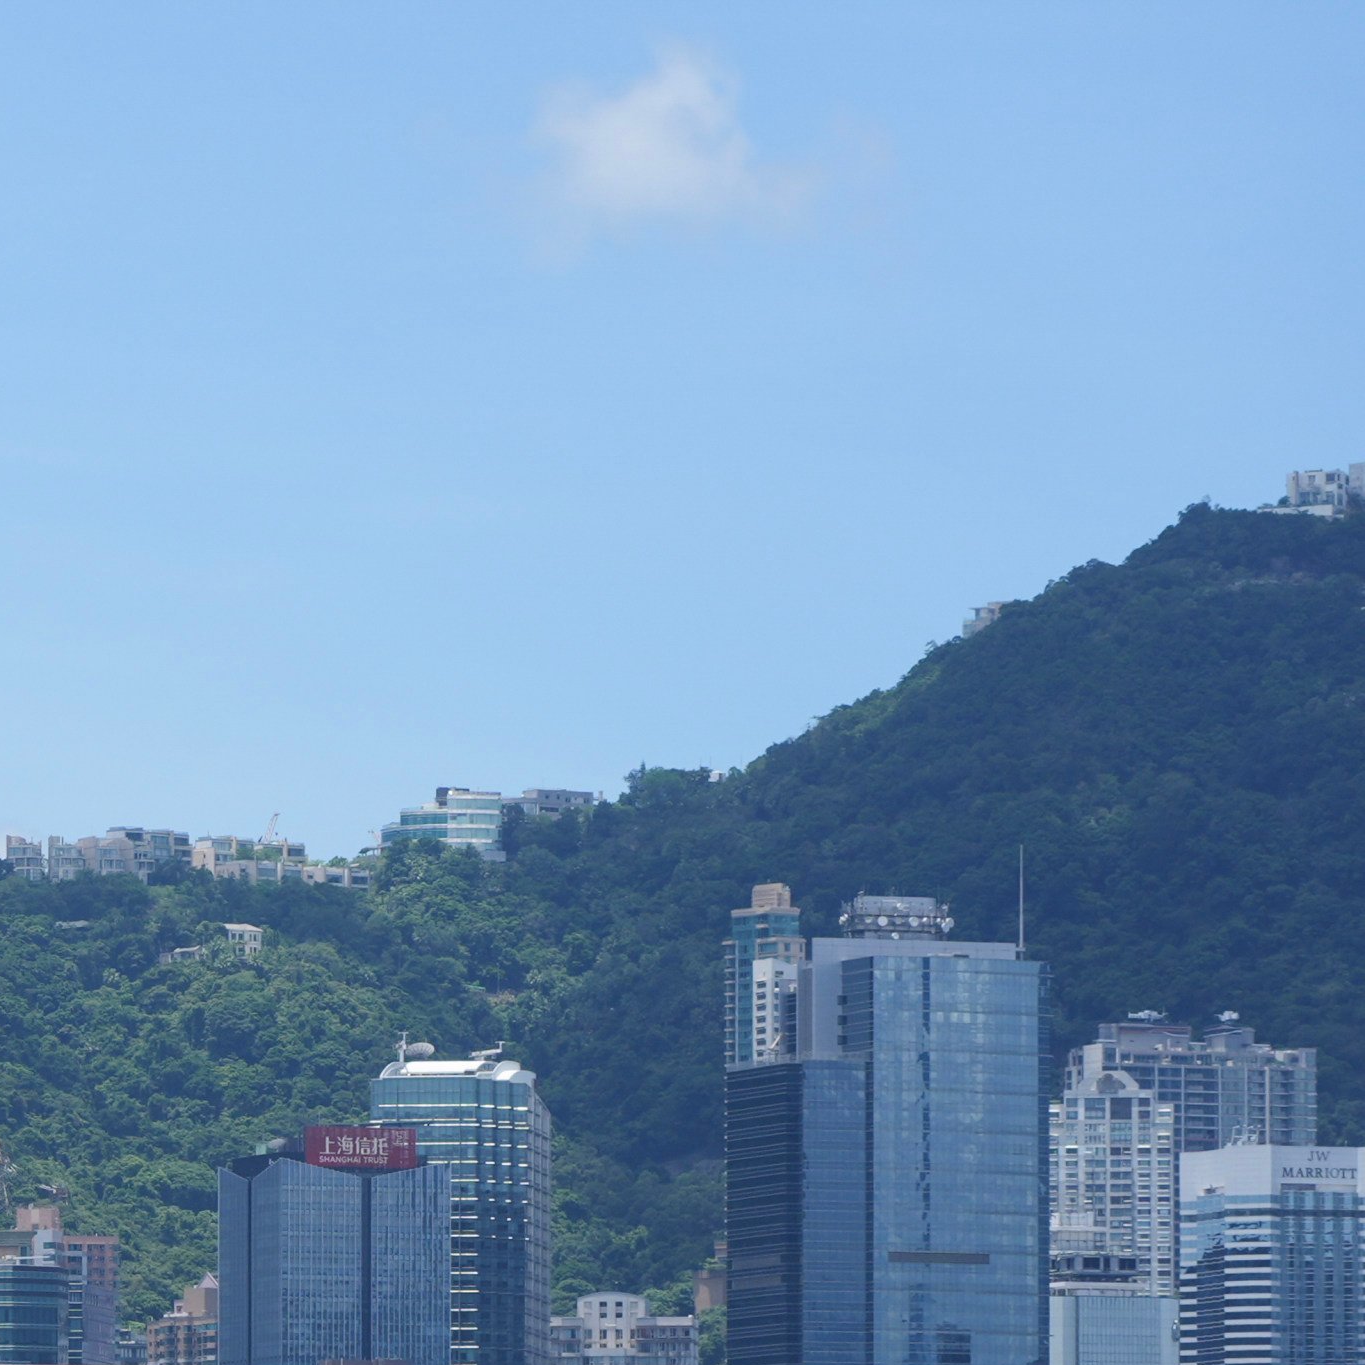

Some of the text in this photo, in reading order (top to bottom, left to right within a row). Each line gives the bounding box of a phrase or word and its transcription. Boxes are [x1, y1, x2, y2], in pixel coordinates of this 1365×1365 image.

[319, 1135, 389, 1156] 上海信托
[319, 1156, 389, 1165] SHANGHAI TRUST
[1307, 1150, 1330, 1162] JW
[1281, 1166, 1358, 1180] MARRIOTT
